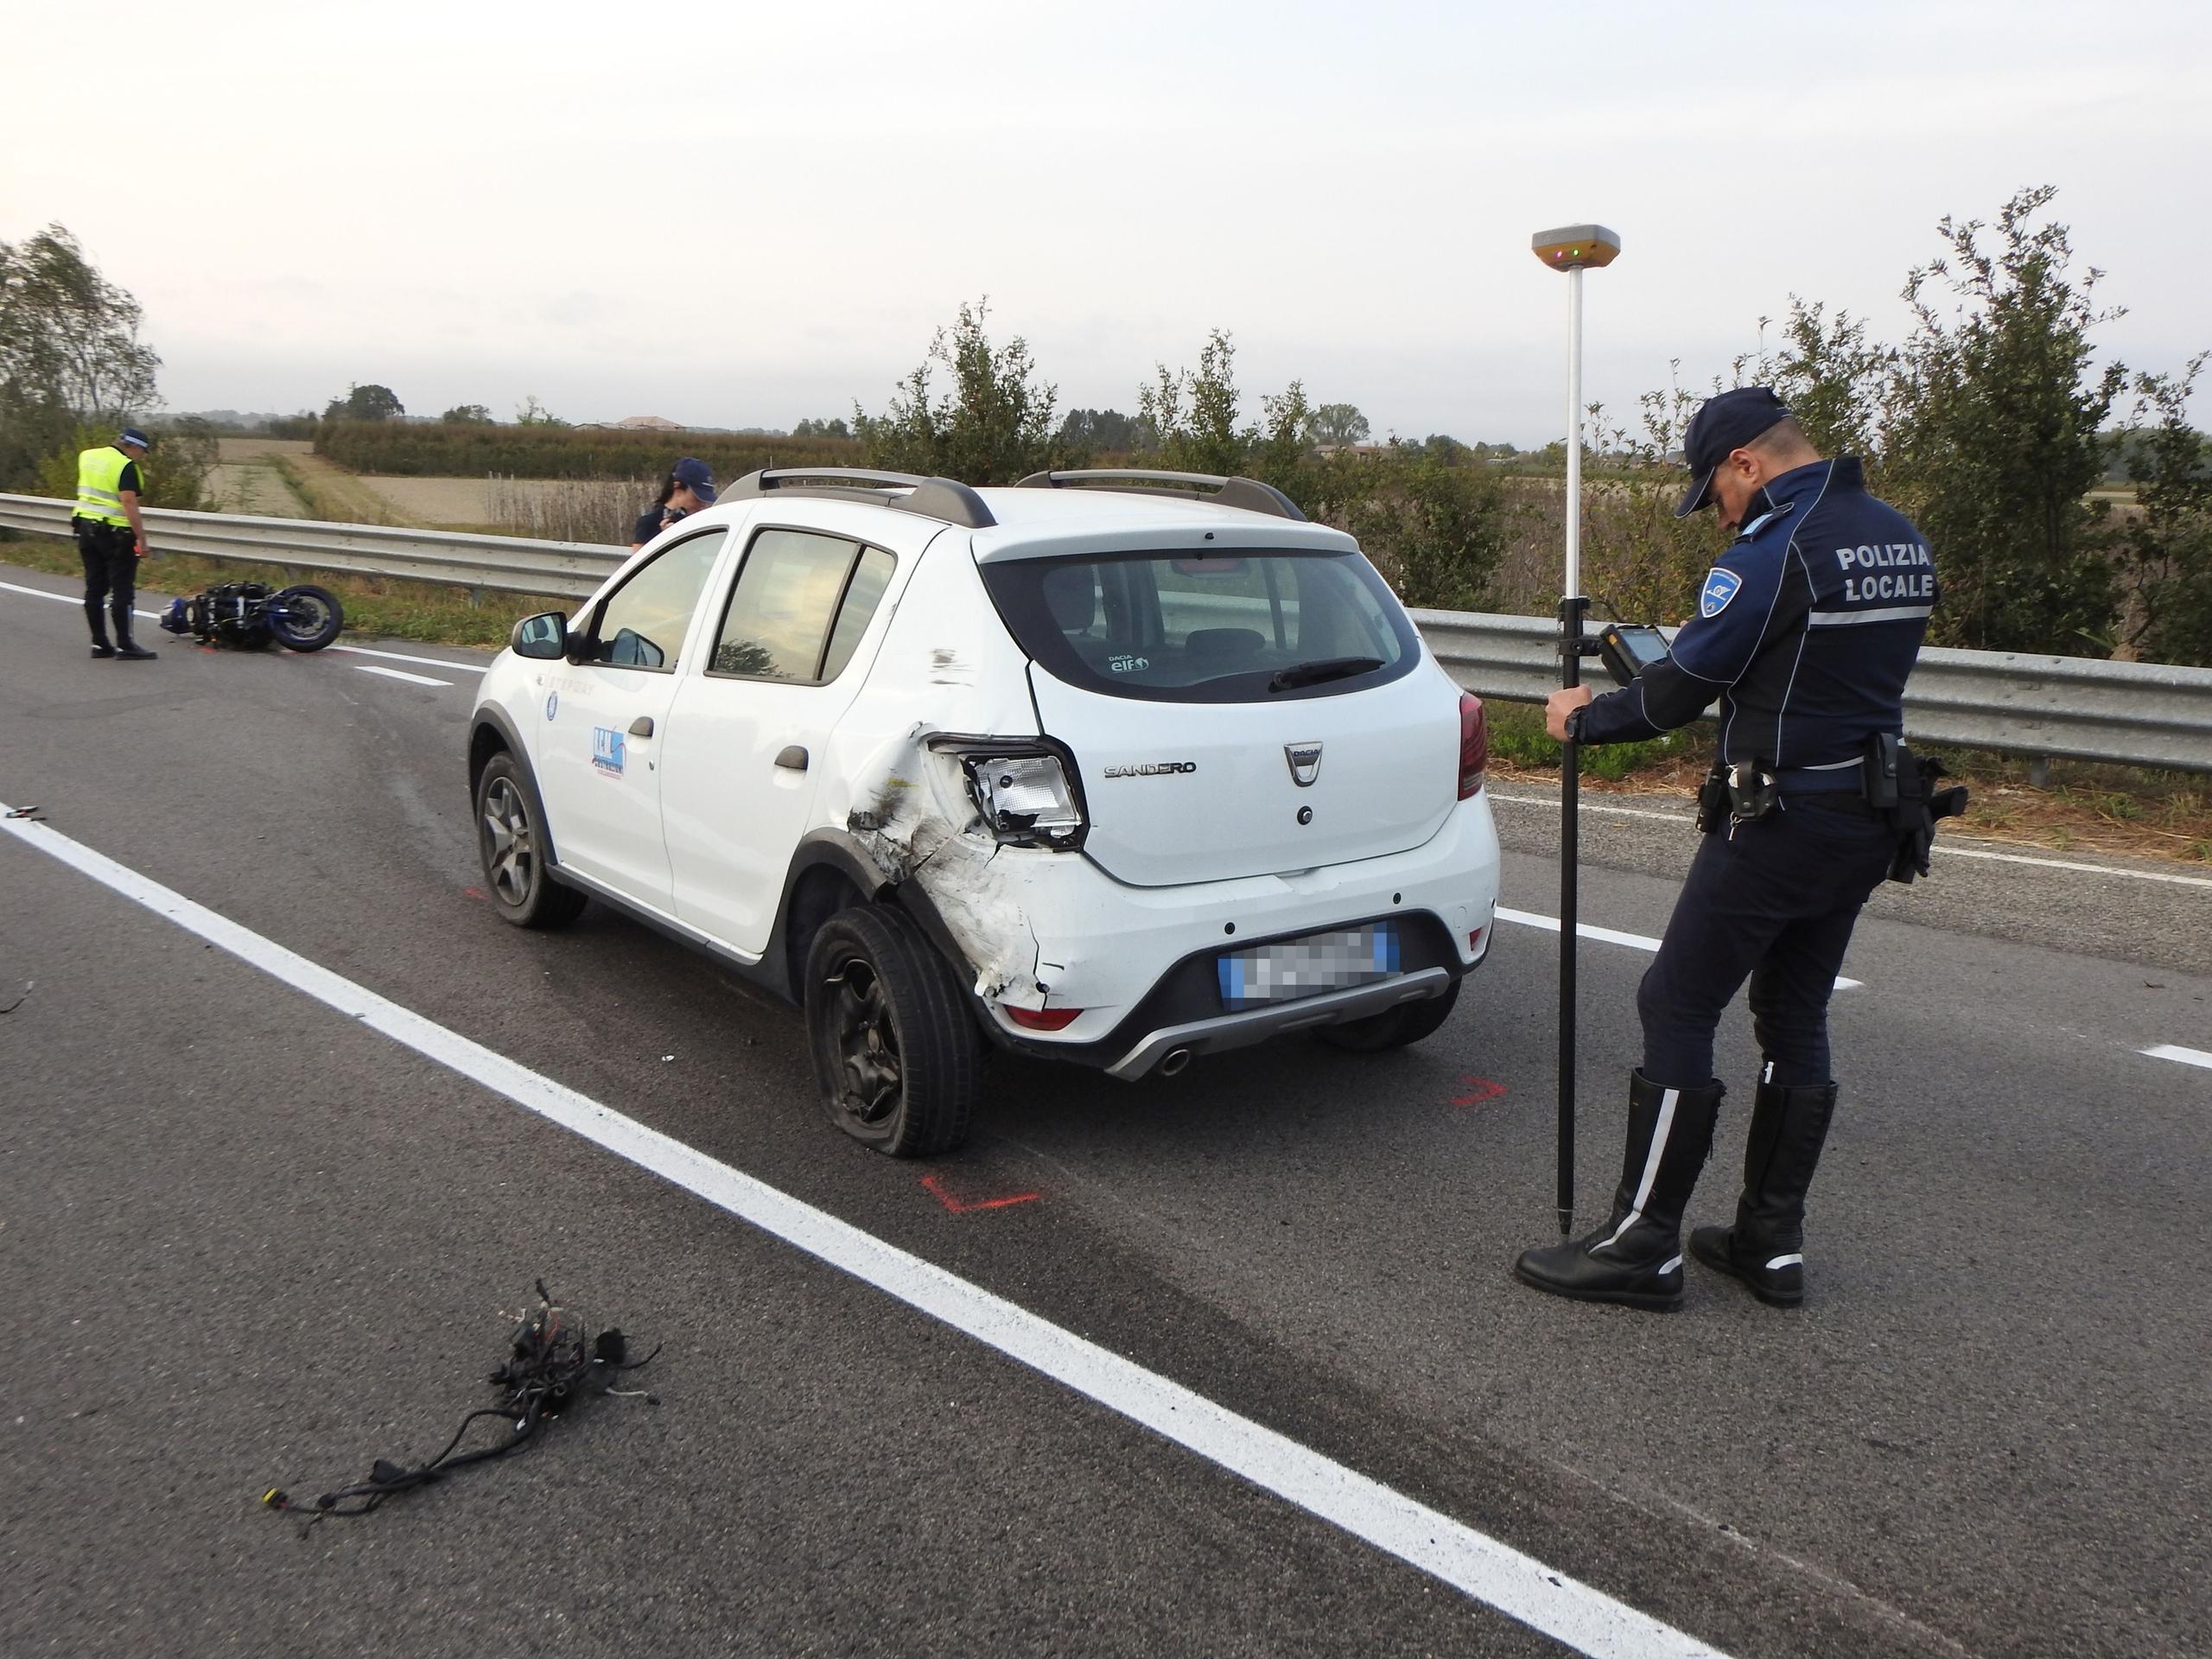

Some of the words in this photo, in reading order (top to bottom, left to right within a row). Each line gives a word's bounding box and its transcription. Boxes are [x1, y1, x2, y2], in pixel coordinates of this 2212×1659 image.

[1835, 543, 1930, 570] POLIZIA
[1845, 575, 1933, 601] LOCALE
[1111, 659, 1135, 671] elf
[1294, 748, 1319, 757] DACIA
[1104, 761, 1197, 779] SANDERO
